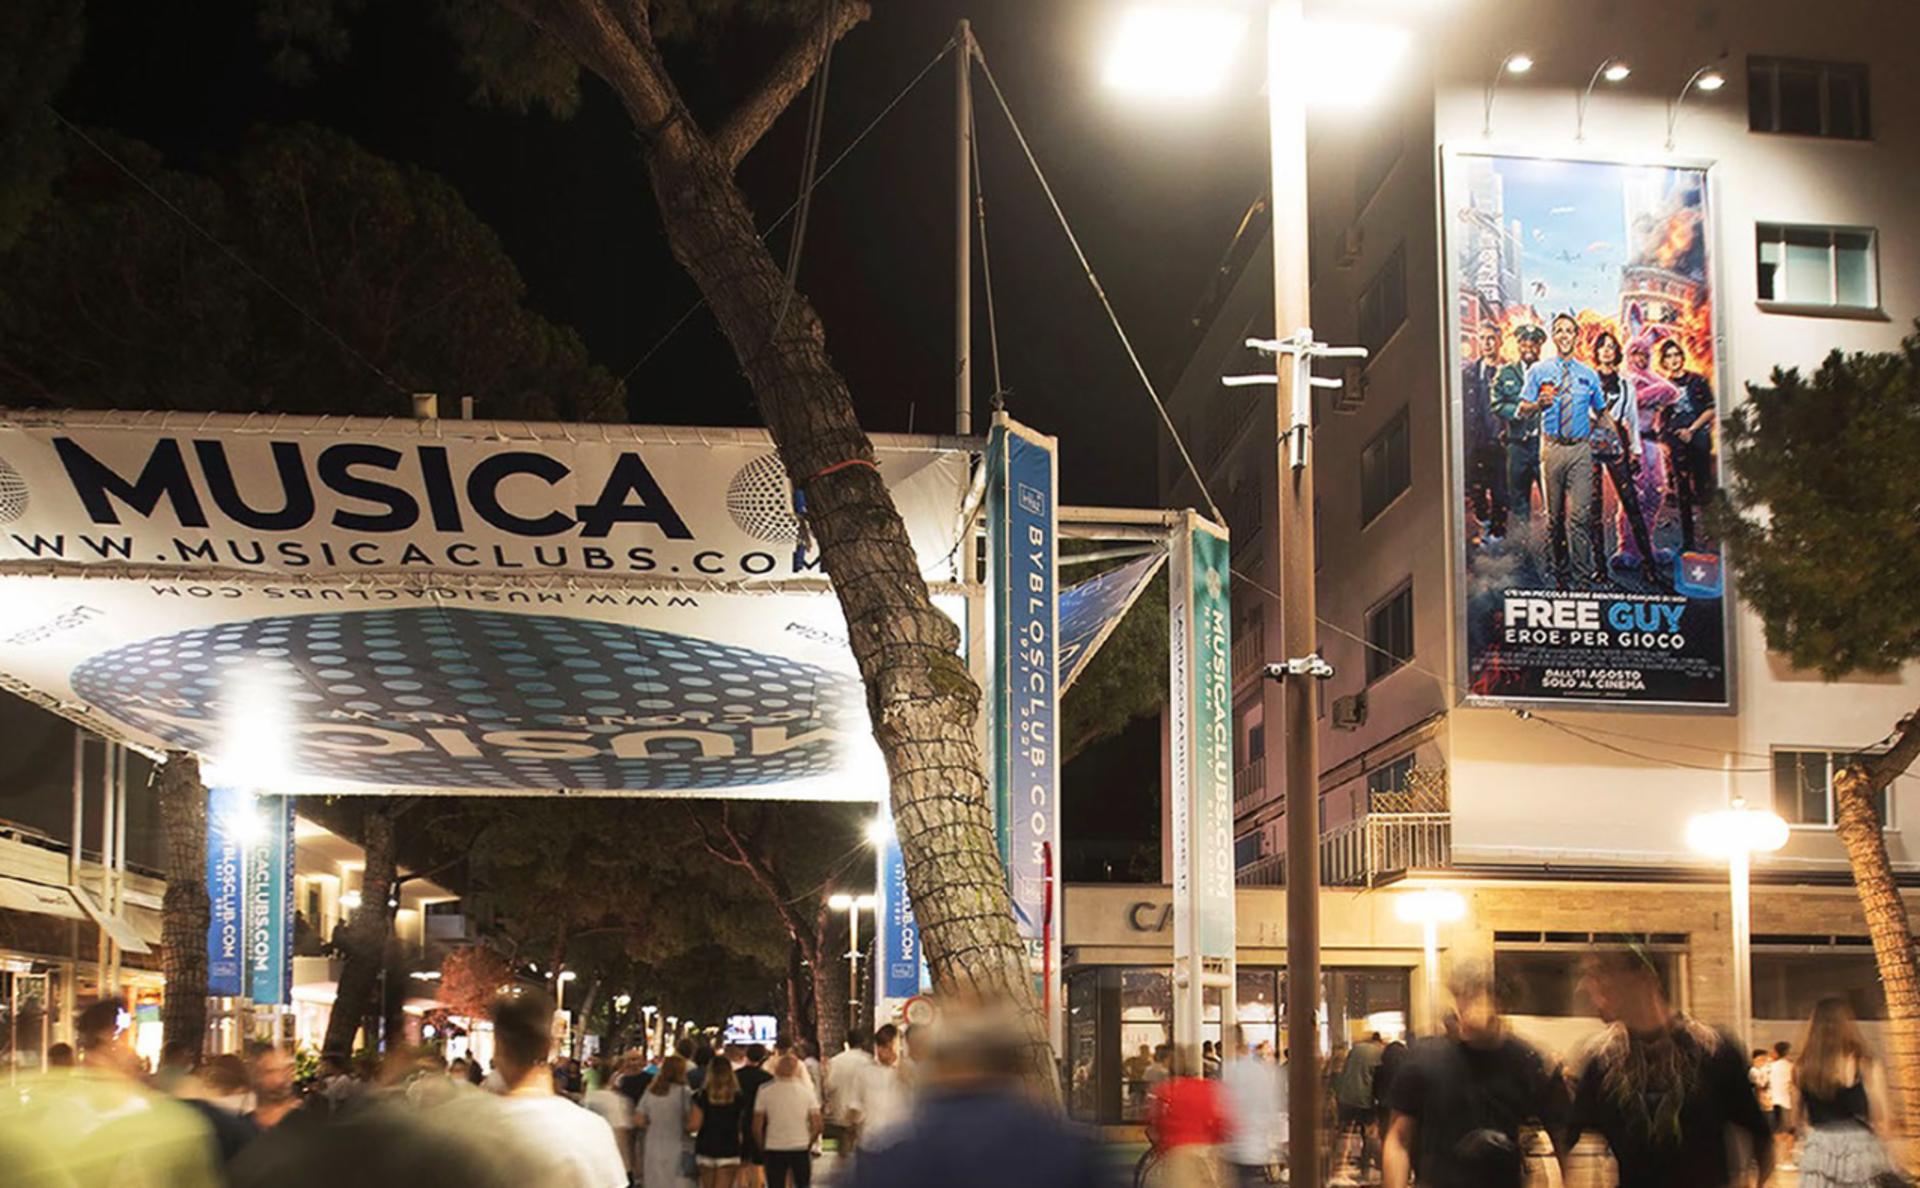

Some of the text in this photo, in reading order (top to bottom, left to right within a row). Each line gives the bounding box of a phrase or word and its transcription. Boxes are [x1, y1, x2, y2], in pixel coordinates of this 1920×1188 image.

[52, 437, 694, 539] MUSICA
[1504, 598, 1686, 633] FREE GUY
[1504, 628, 1686, 650] EROE PER GIOCO
[1542, 677, 1577, 688] SOLO
[1595, 679, 1646, 690] CINEMA
[1589, 669, 1642, 680] AGOSTO
[1028, 525, 1046, 865] BYBLOSCLUB.COM
[1213, 610, 1228, 898] MUSICACLUBS.COM
